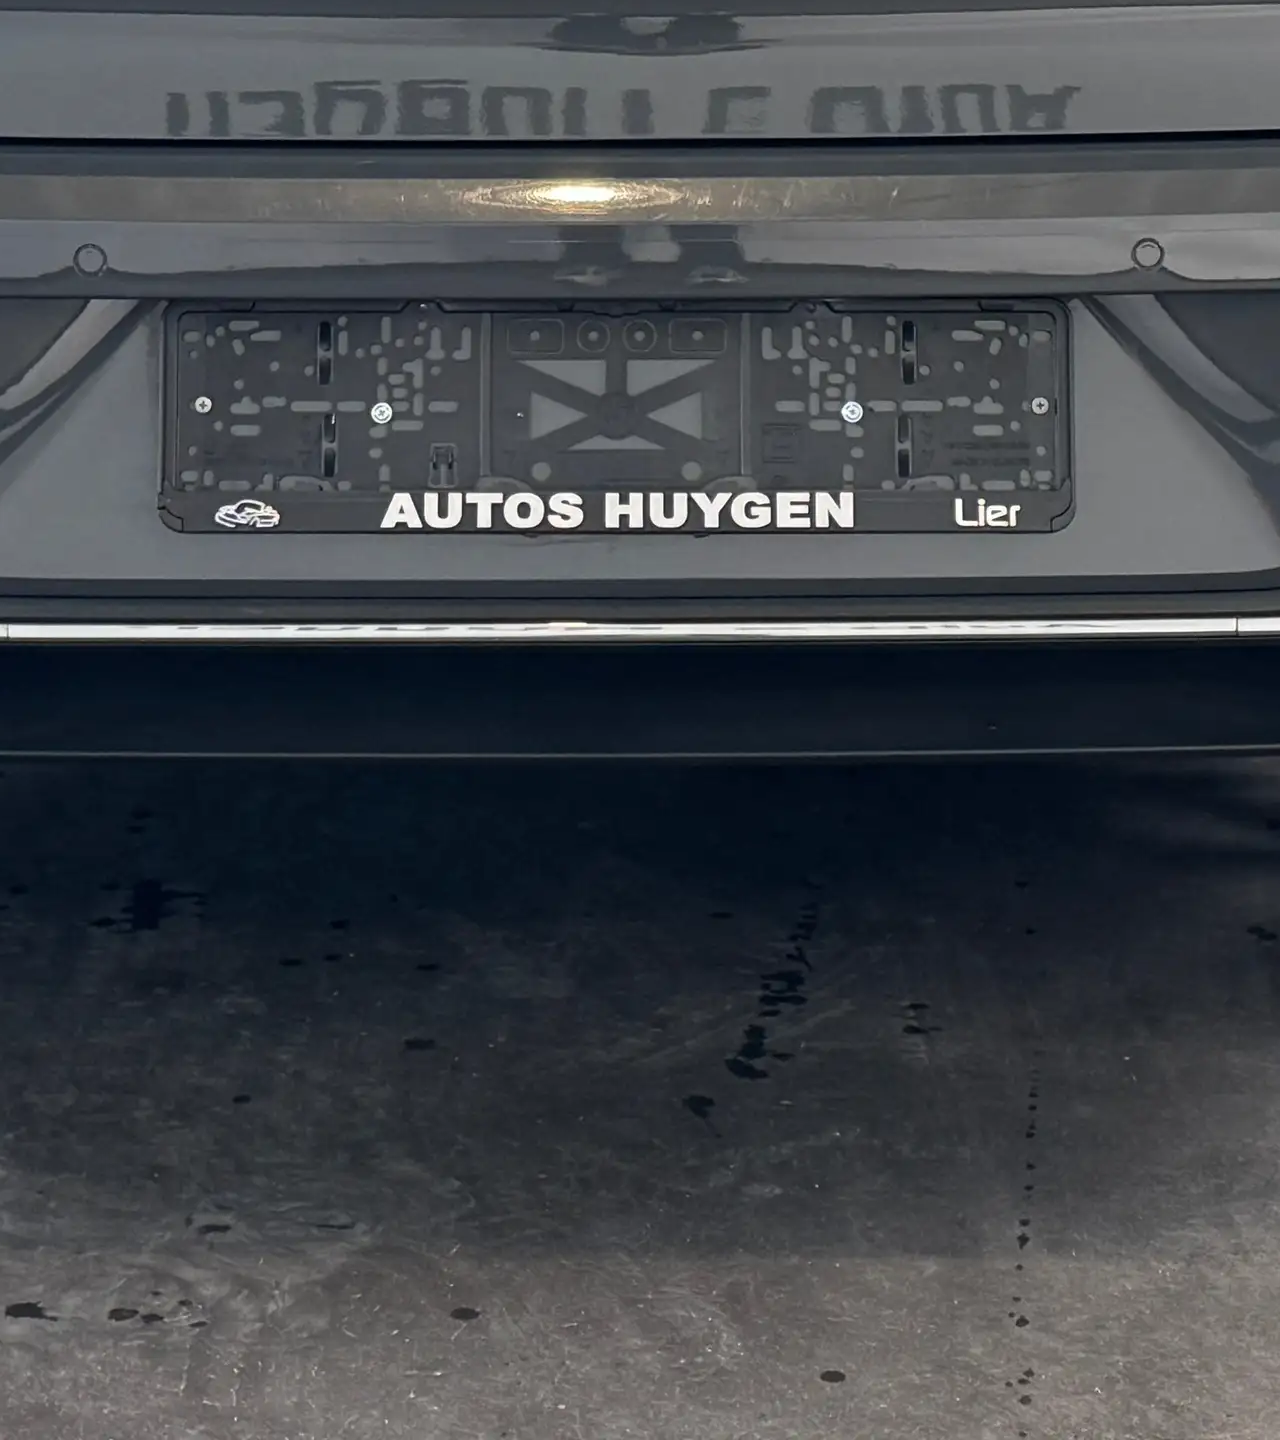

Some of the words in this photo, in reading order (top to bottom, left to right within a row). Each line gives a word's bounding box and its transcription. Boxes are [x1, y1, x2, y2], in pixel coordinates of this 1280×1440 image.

[380, 492, 584, 529] AUTOS
[604, 492, 855, 529] HUYGEN
[954, 499, 1021, 527] Lier
